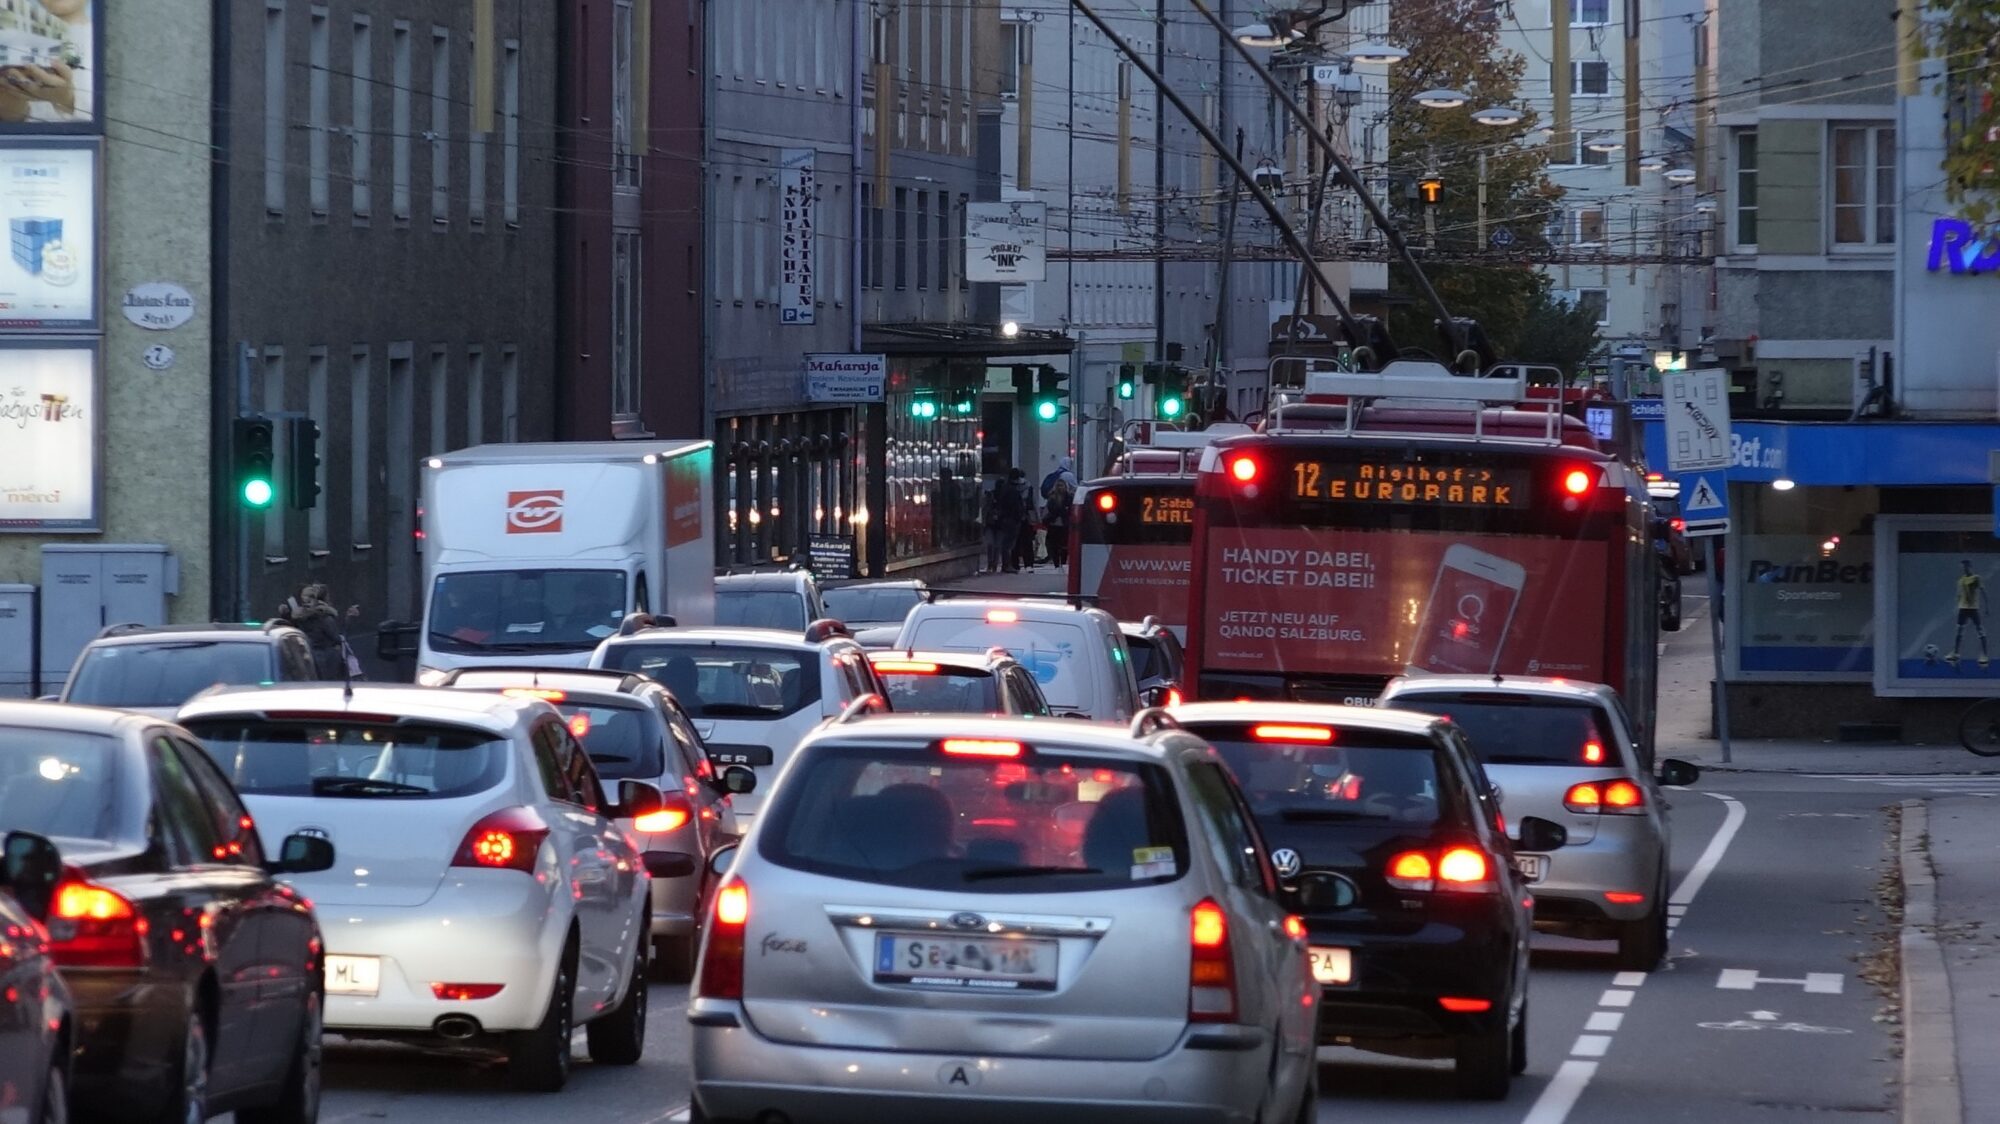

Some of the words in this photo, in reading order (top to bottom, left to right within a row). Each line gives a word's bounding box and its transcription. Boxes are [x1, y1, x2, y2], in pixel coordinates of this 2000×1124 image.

[1318, 69, 1333, 79] 87
[784, 185, 798, 284] INDISCHE
[799, 165, 812, 305] SPEZIALITÄTEN
[991, 244, 1022, 254] PROJECT
[997, 254, 1015, 267] INK
[809, 360, 880, 375] Maharaja
[1294, 462, 1320, 497] 12
[1331, 479, 1511, 504] EUROPARK
[1142, 497, 1153, 523] 2
[1222, 548, 1300, 566] HANDY
[1304, 551, 1376, 571] DABEI,
[1221, 567, 1300, 586] TICKET
[1304, 571, 1376, 589] DABEI!
[1747, 559, 1874, 584] RunBet
[1219, 611, 1268, 623] JETZT
[1271, 612, 1304, 625] NEU
[1307, 614, 1340, 626] AUF
[1219, 625, 1276, 640] QANDO
[1279, 628, 1366, 641] SALZBURG.
[335, 963, 361, 984] ML
[949, 1066, 970, 1086] A
